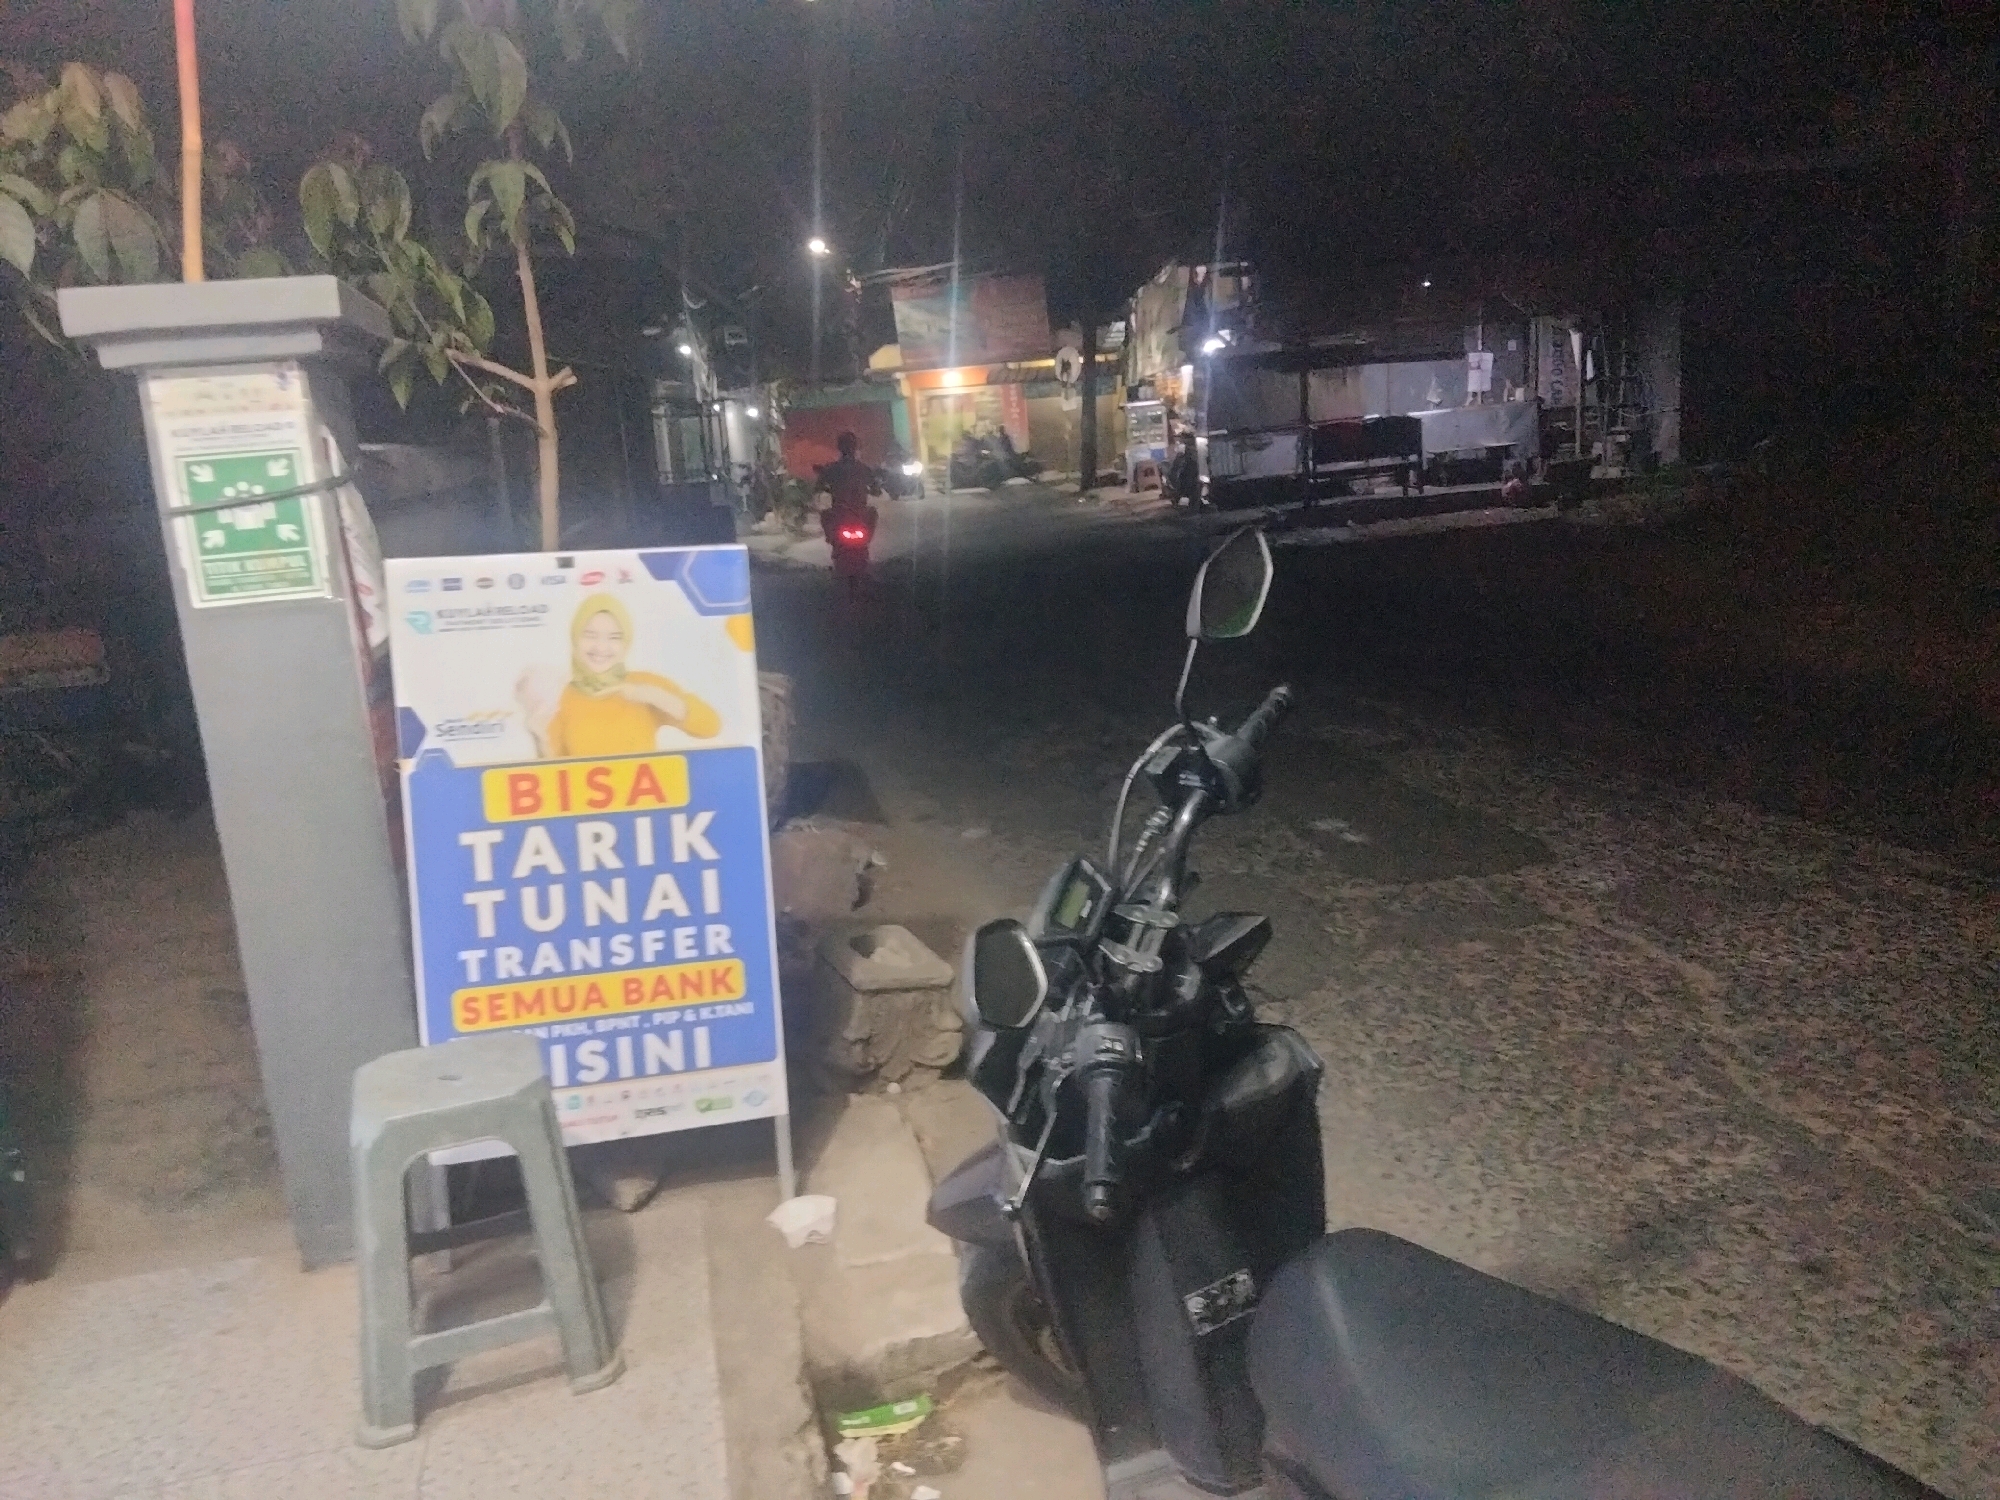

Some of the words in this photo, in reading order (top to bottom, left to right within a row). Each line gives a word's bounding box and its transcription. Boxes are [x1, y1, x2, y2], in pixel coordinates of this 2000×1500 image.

[508, 763, 667, 816] BISA
[458, 810, 721, 882] TARIK
[463, 868, 722, 938] TUNAI
[458, 924, 735, 982] TRANSFER
[460, 982, 608, 1026] SEMUA
[622, 966, 736, 1006] BANK
[550, 1026, 711, 1087] ISINI
